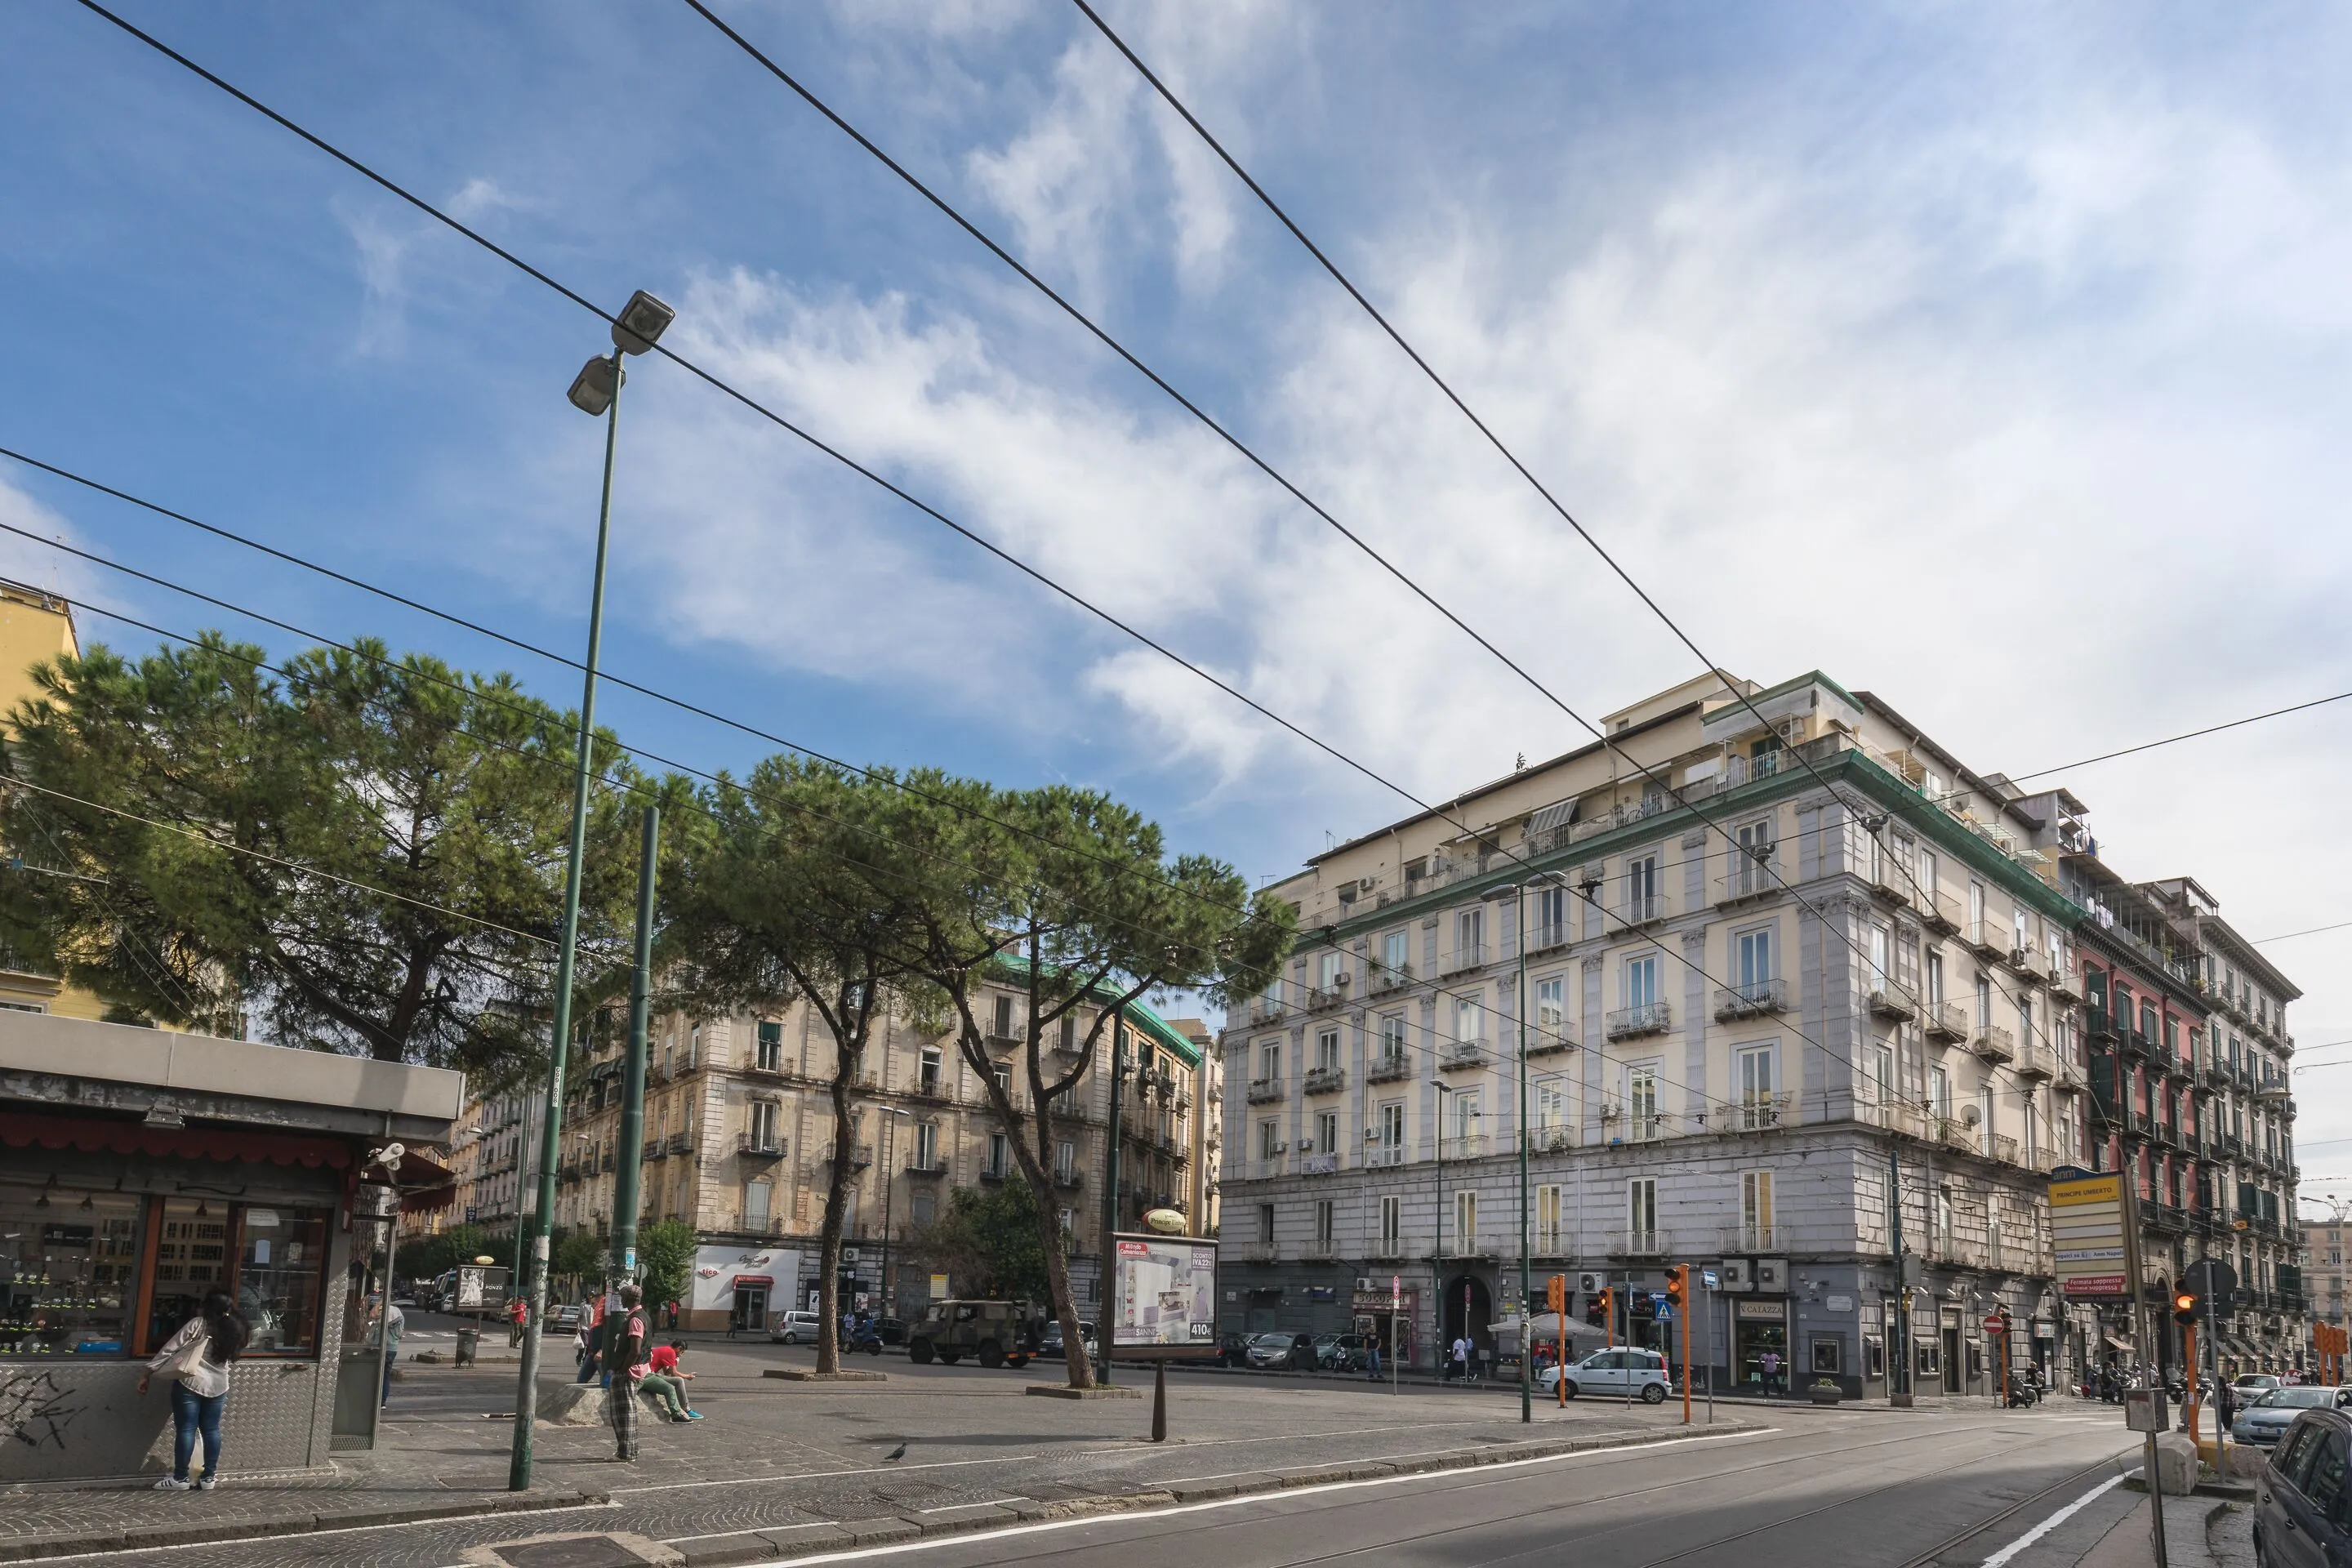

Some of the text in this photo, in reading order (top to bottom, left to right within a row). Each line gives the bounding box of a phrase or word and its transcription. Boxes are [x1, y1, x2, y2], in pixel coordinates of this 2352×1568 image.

[2053, 1169, 2075, 1180] anm
[2056, 1187, 2113, 1198] PRINCIPE UMBERTO
[1151, 1218, 1171, 1226] Principe
[2092, 1277, 2122, 1285] soppressa
[1747, 1306, 1783, 1314] CAIAZZA
